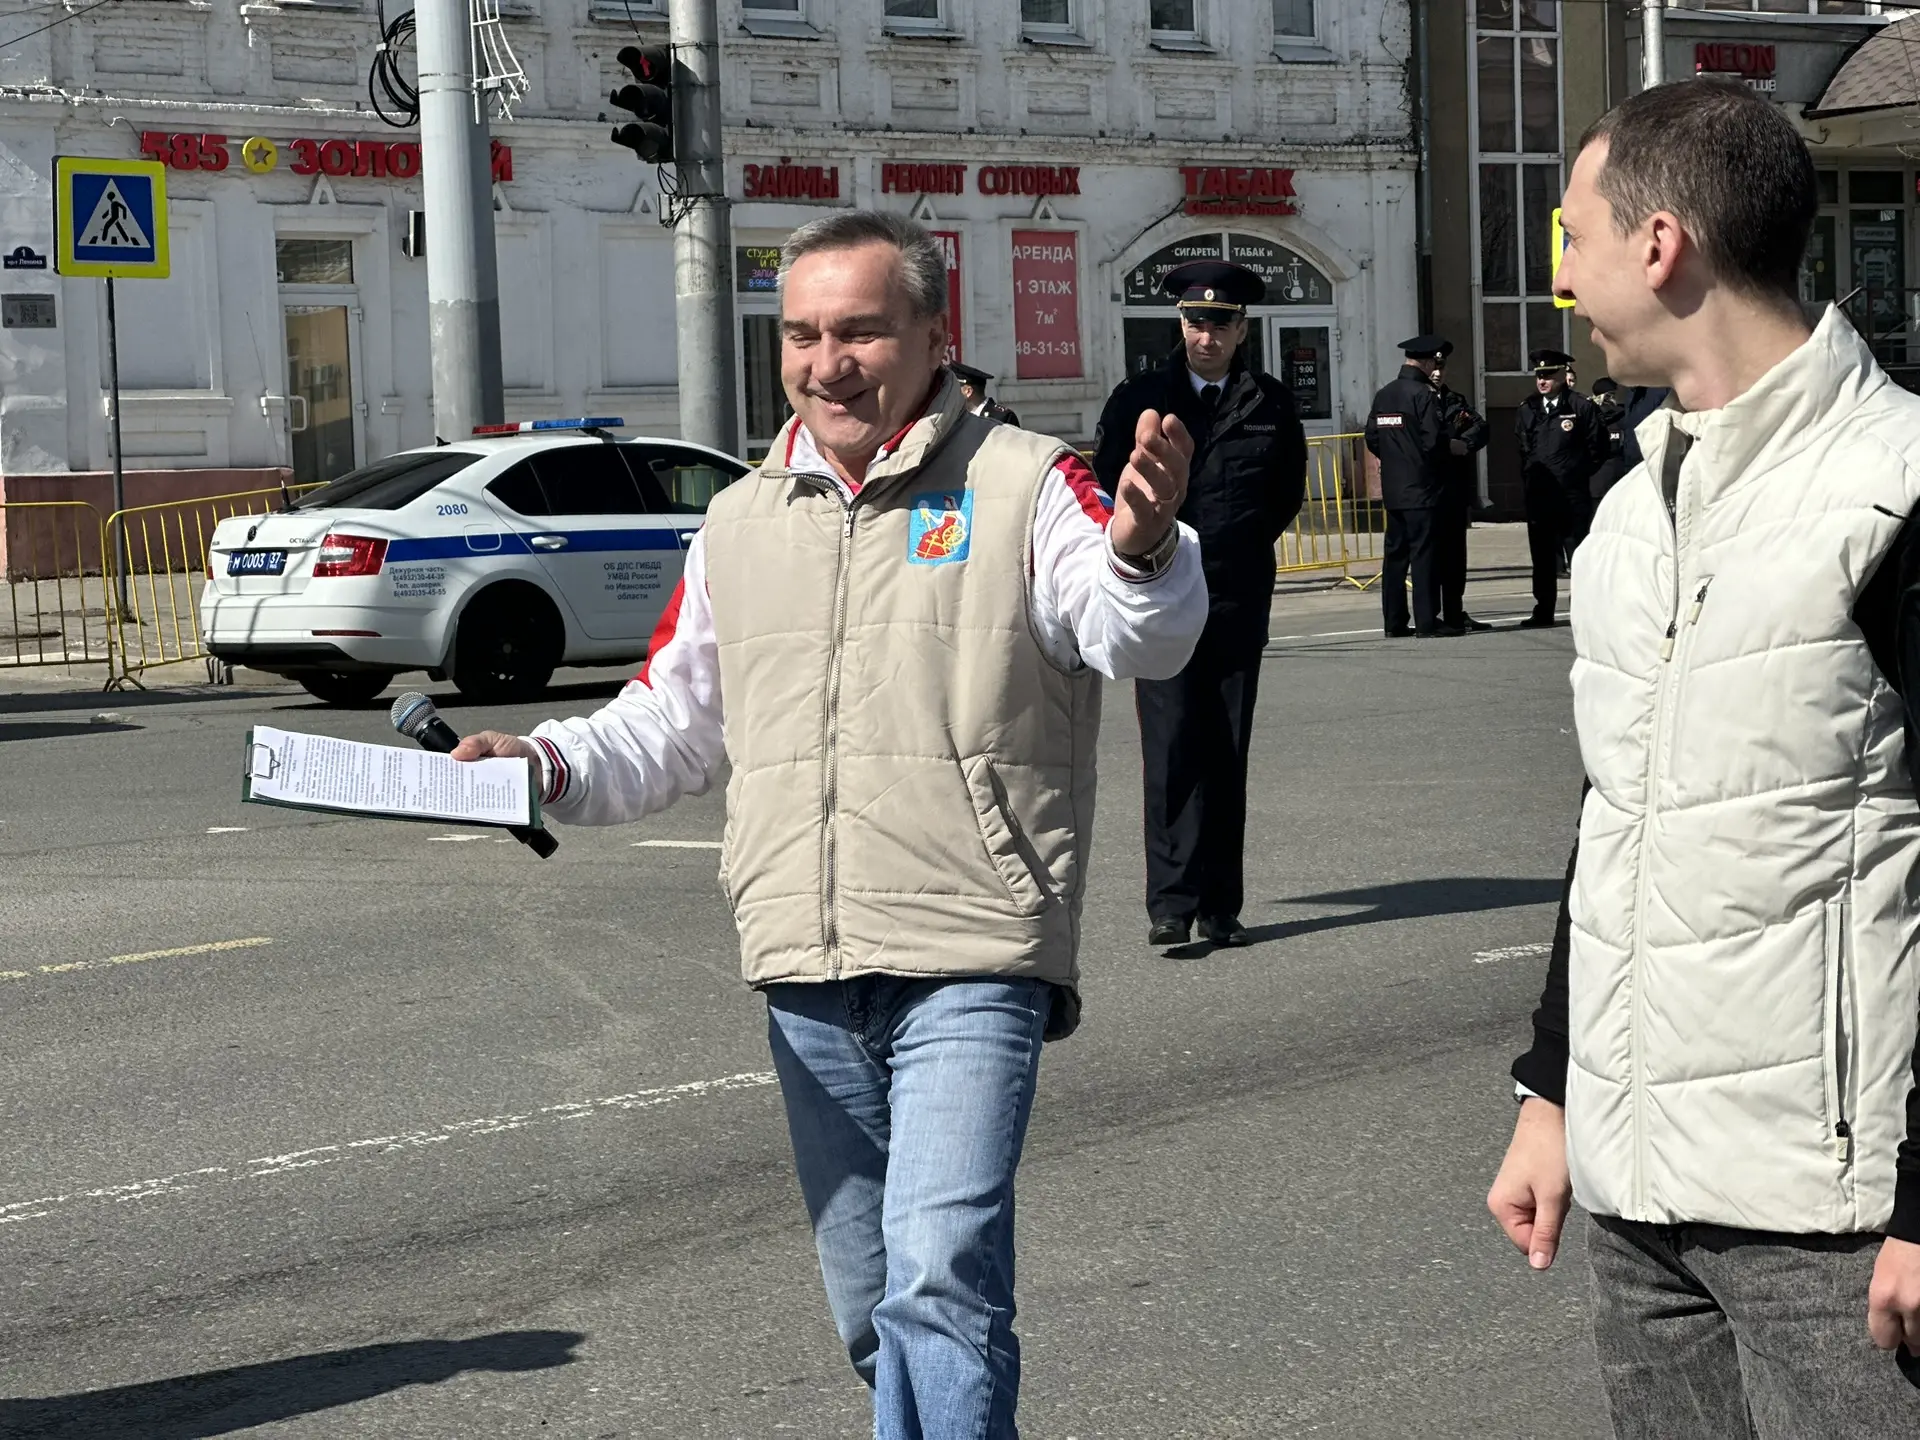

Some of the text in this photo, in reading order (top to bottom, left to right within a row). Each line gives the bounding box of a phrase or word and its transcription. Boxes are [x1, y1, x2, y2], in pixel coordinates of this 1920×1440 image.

[1696, 43, 1776, 73] NEON
[141, 131, 229, 171] 585
[743, 156, 839, 198] ЗАЙМЫ
[882, 163, 1081, 195] РЕМОНТ СОТОВЫХ
[1178, 166, 1298, 197] ТАБАК
[21, 248, 26, 257] 1
[1012, 245, 1074, 263] АРЕНДА
[1174, 247, 1220, 256] СИГАРЕТЫ
[1234, 247, 1265, 256] ТАБАК
[1266, 266, 1284, 275] для
[1016, 280, 1072, 294] 1 ЭТАЖ
[1299, 365, 1314, 373] 9:00
[1298, 378, 1316, 386] 21:00
[436, 503, 468, 516] 2080
[242, 553, 266, 568] 0003
[270, 552, 282, 563] 37
[617, 561, 634, 571] ДПС
[636, 560, 662, 570] ГИБДД
[607, 571, 658, 581] УМВД России
[616, 582, 661, 591] Ивановской
[617, 592, 648, 600] области
